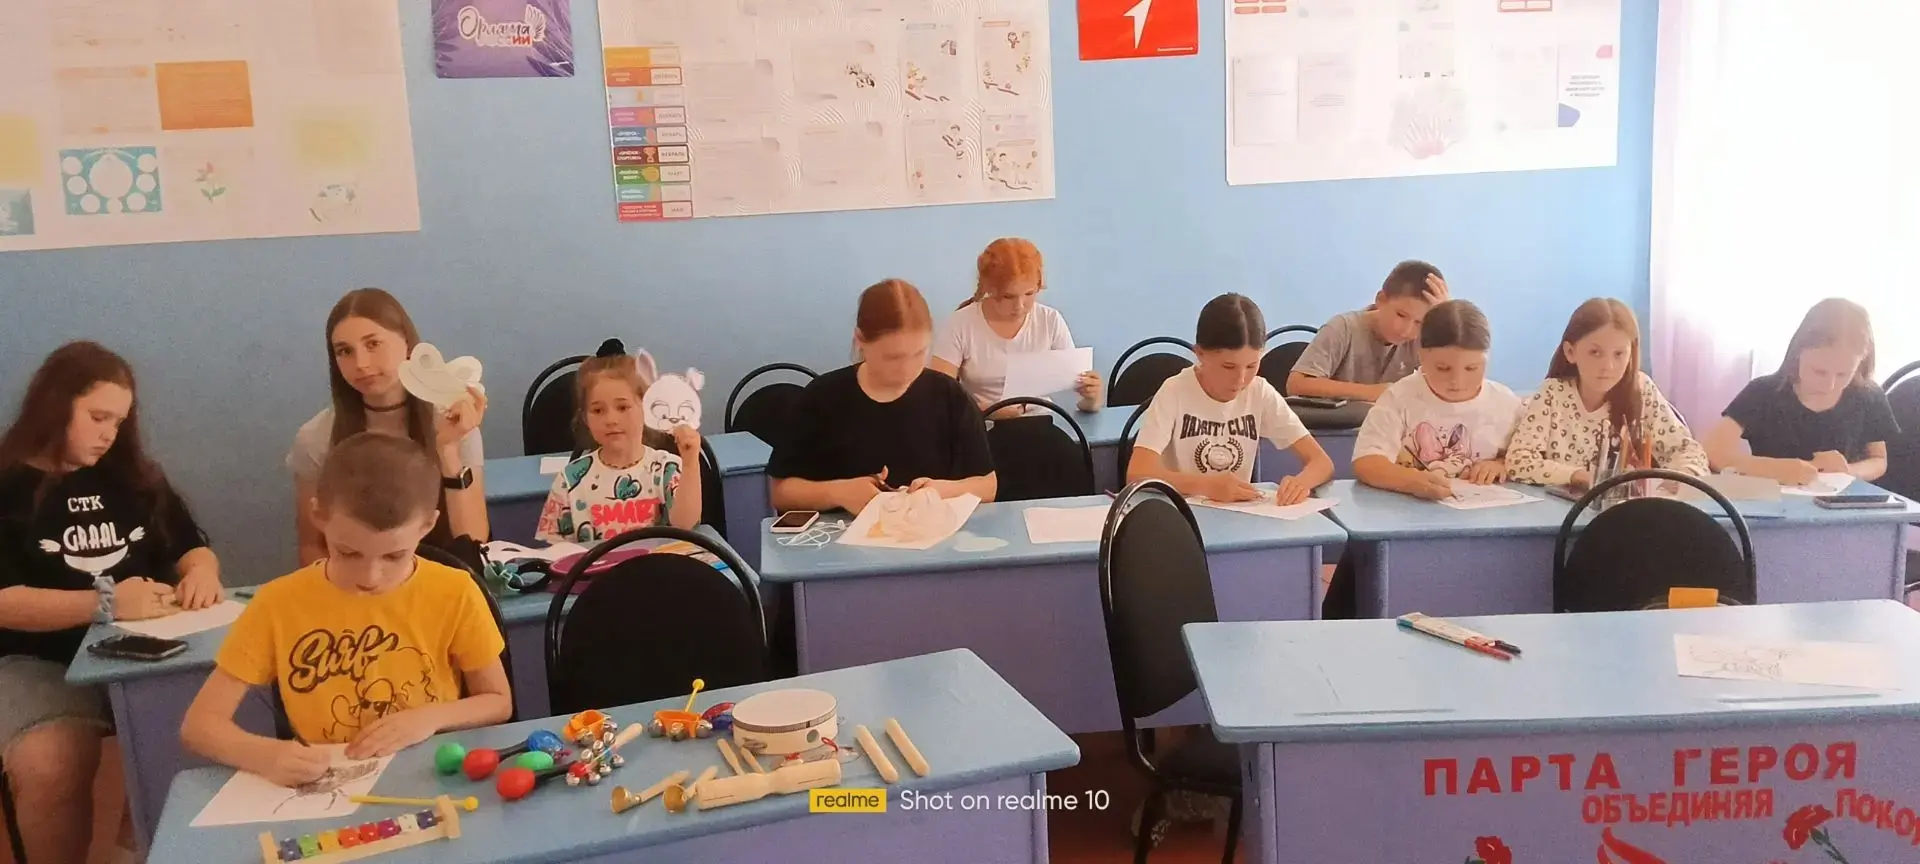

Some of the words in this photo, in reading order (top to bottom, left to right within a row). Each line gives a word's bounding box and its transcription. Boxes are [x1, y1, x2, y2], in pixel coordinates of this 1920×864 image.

[63, 522, 126, 552] GRAAL
[288, 625, 399, 693] Surf
[1424, 752, 1622, 796] ПАРТА
[1673, 741, 1858, 787] ГЕРОЯ
[1581, 789, 1774, 827] ОБЪЕДИНЯЯ
